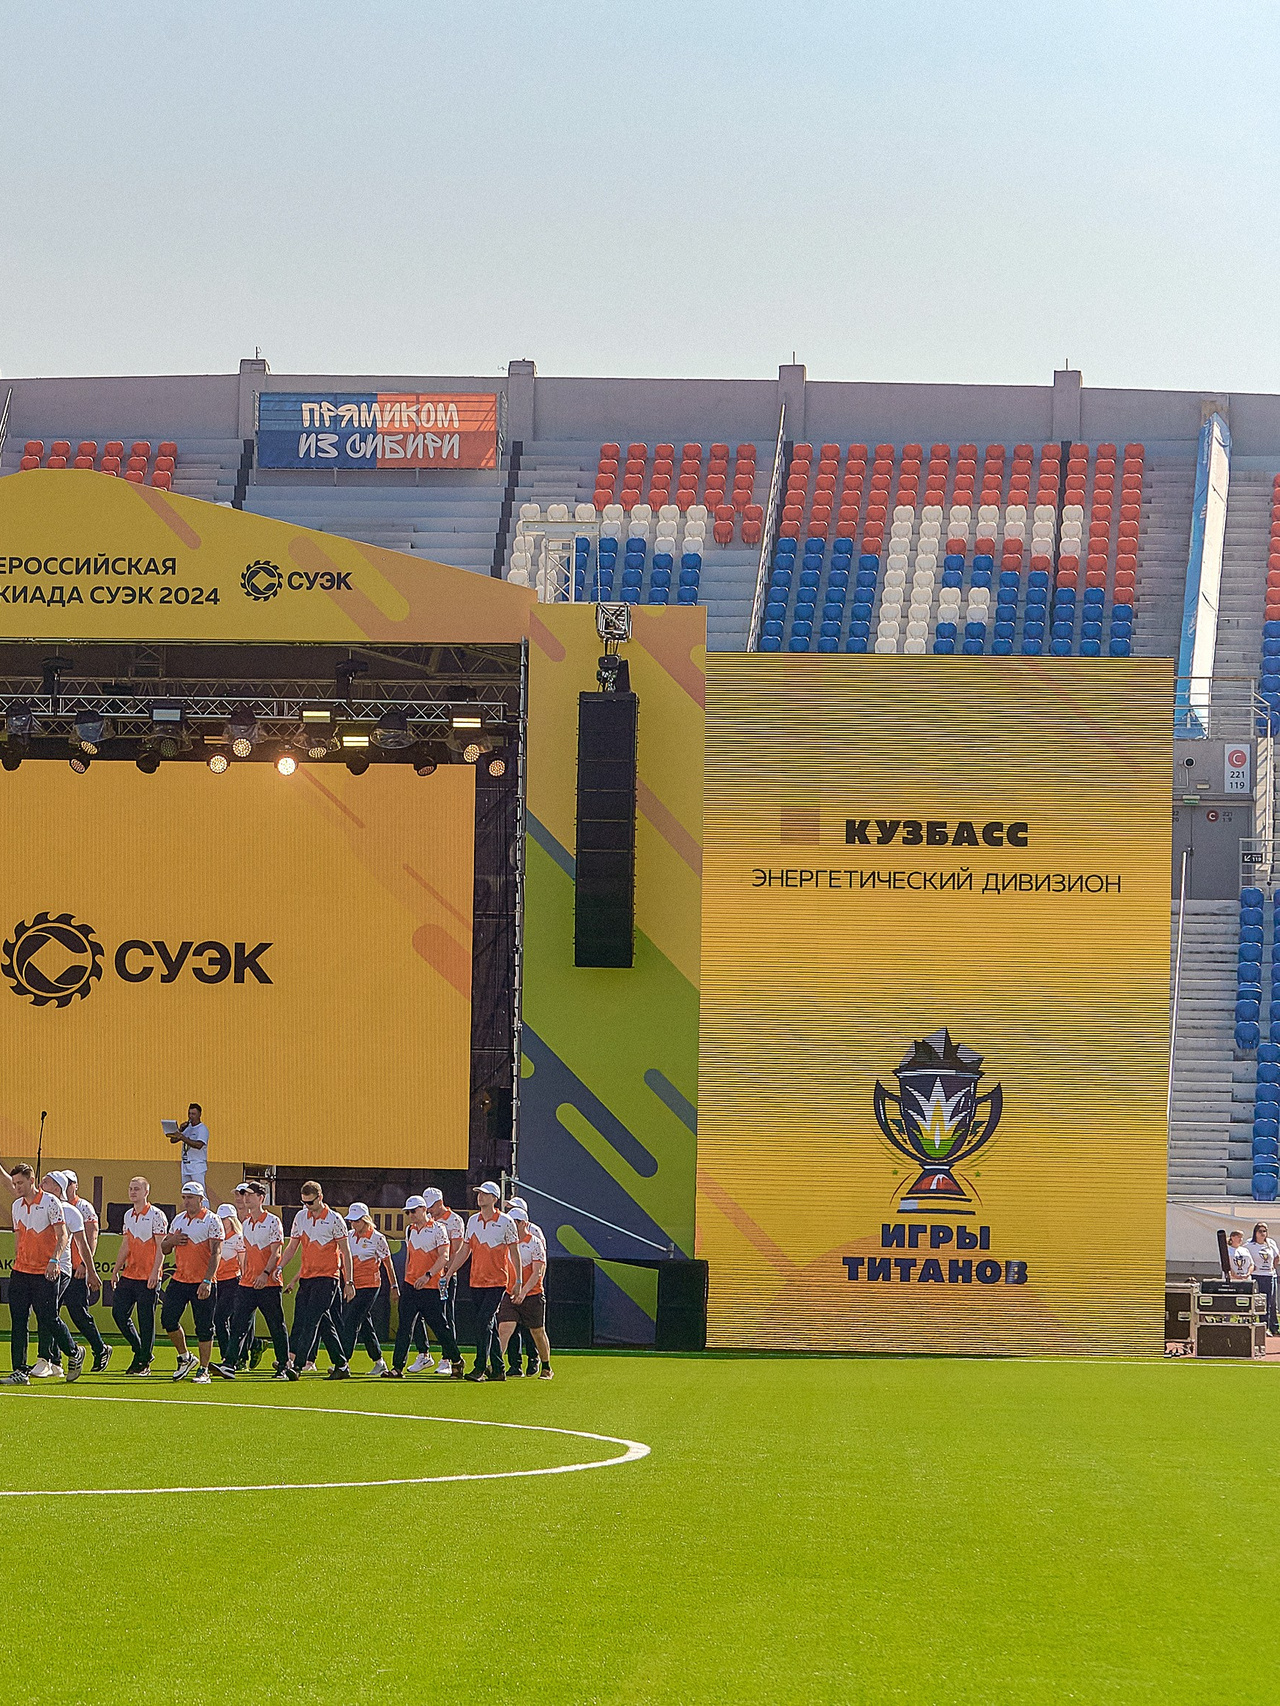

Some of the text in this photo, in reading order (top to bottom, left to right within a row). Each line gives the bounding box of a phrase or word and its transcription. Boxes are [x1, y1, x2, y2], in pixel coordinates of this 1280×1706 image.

[301, 402, 460, 429] ПРЯМИКОМ
[298, 432, 460, 459] ИЗ СИБИРИ
[287, 571, 353, 591] СУЭК
[89, 586, 154, 606] СУЭК
[159, 586, 220, 606] 2024
[1230, 771, 1245, 779] 221
[1230, 782, 1245, 790] 119
[845, 820, 1029, 847] КУЗБАСС
[752, 867, 1122, 895] ЭНЕРГЕТИЧЕСКИЙ ДИВИЗИОН
[114, 939, 274, 986] СУЭК
[881, 1223, 991, 1250] ИГРЫ
[842, 1256, 1029, 1285] ТИТАНОВ
